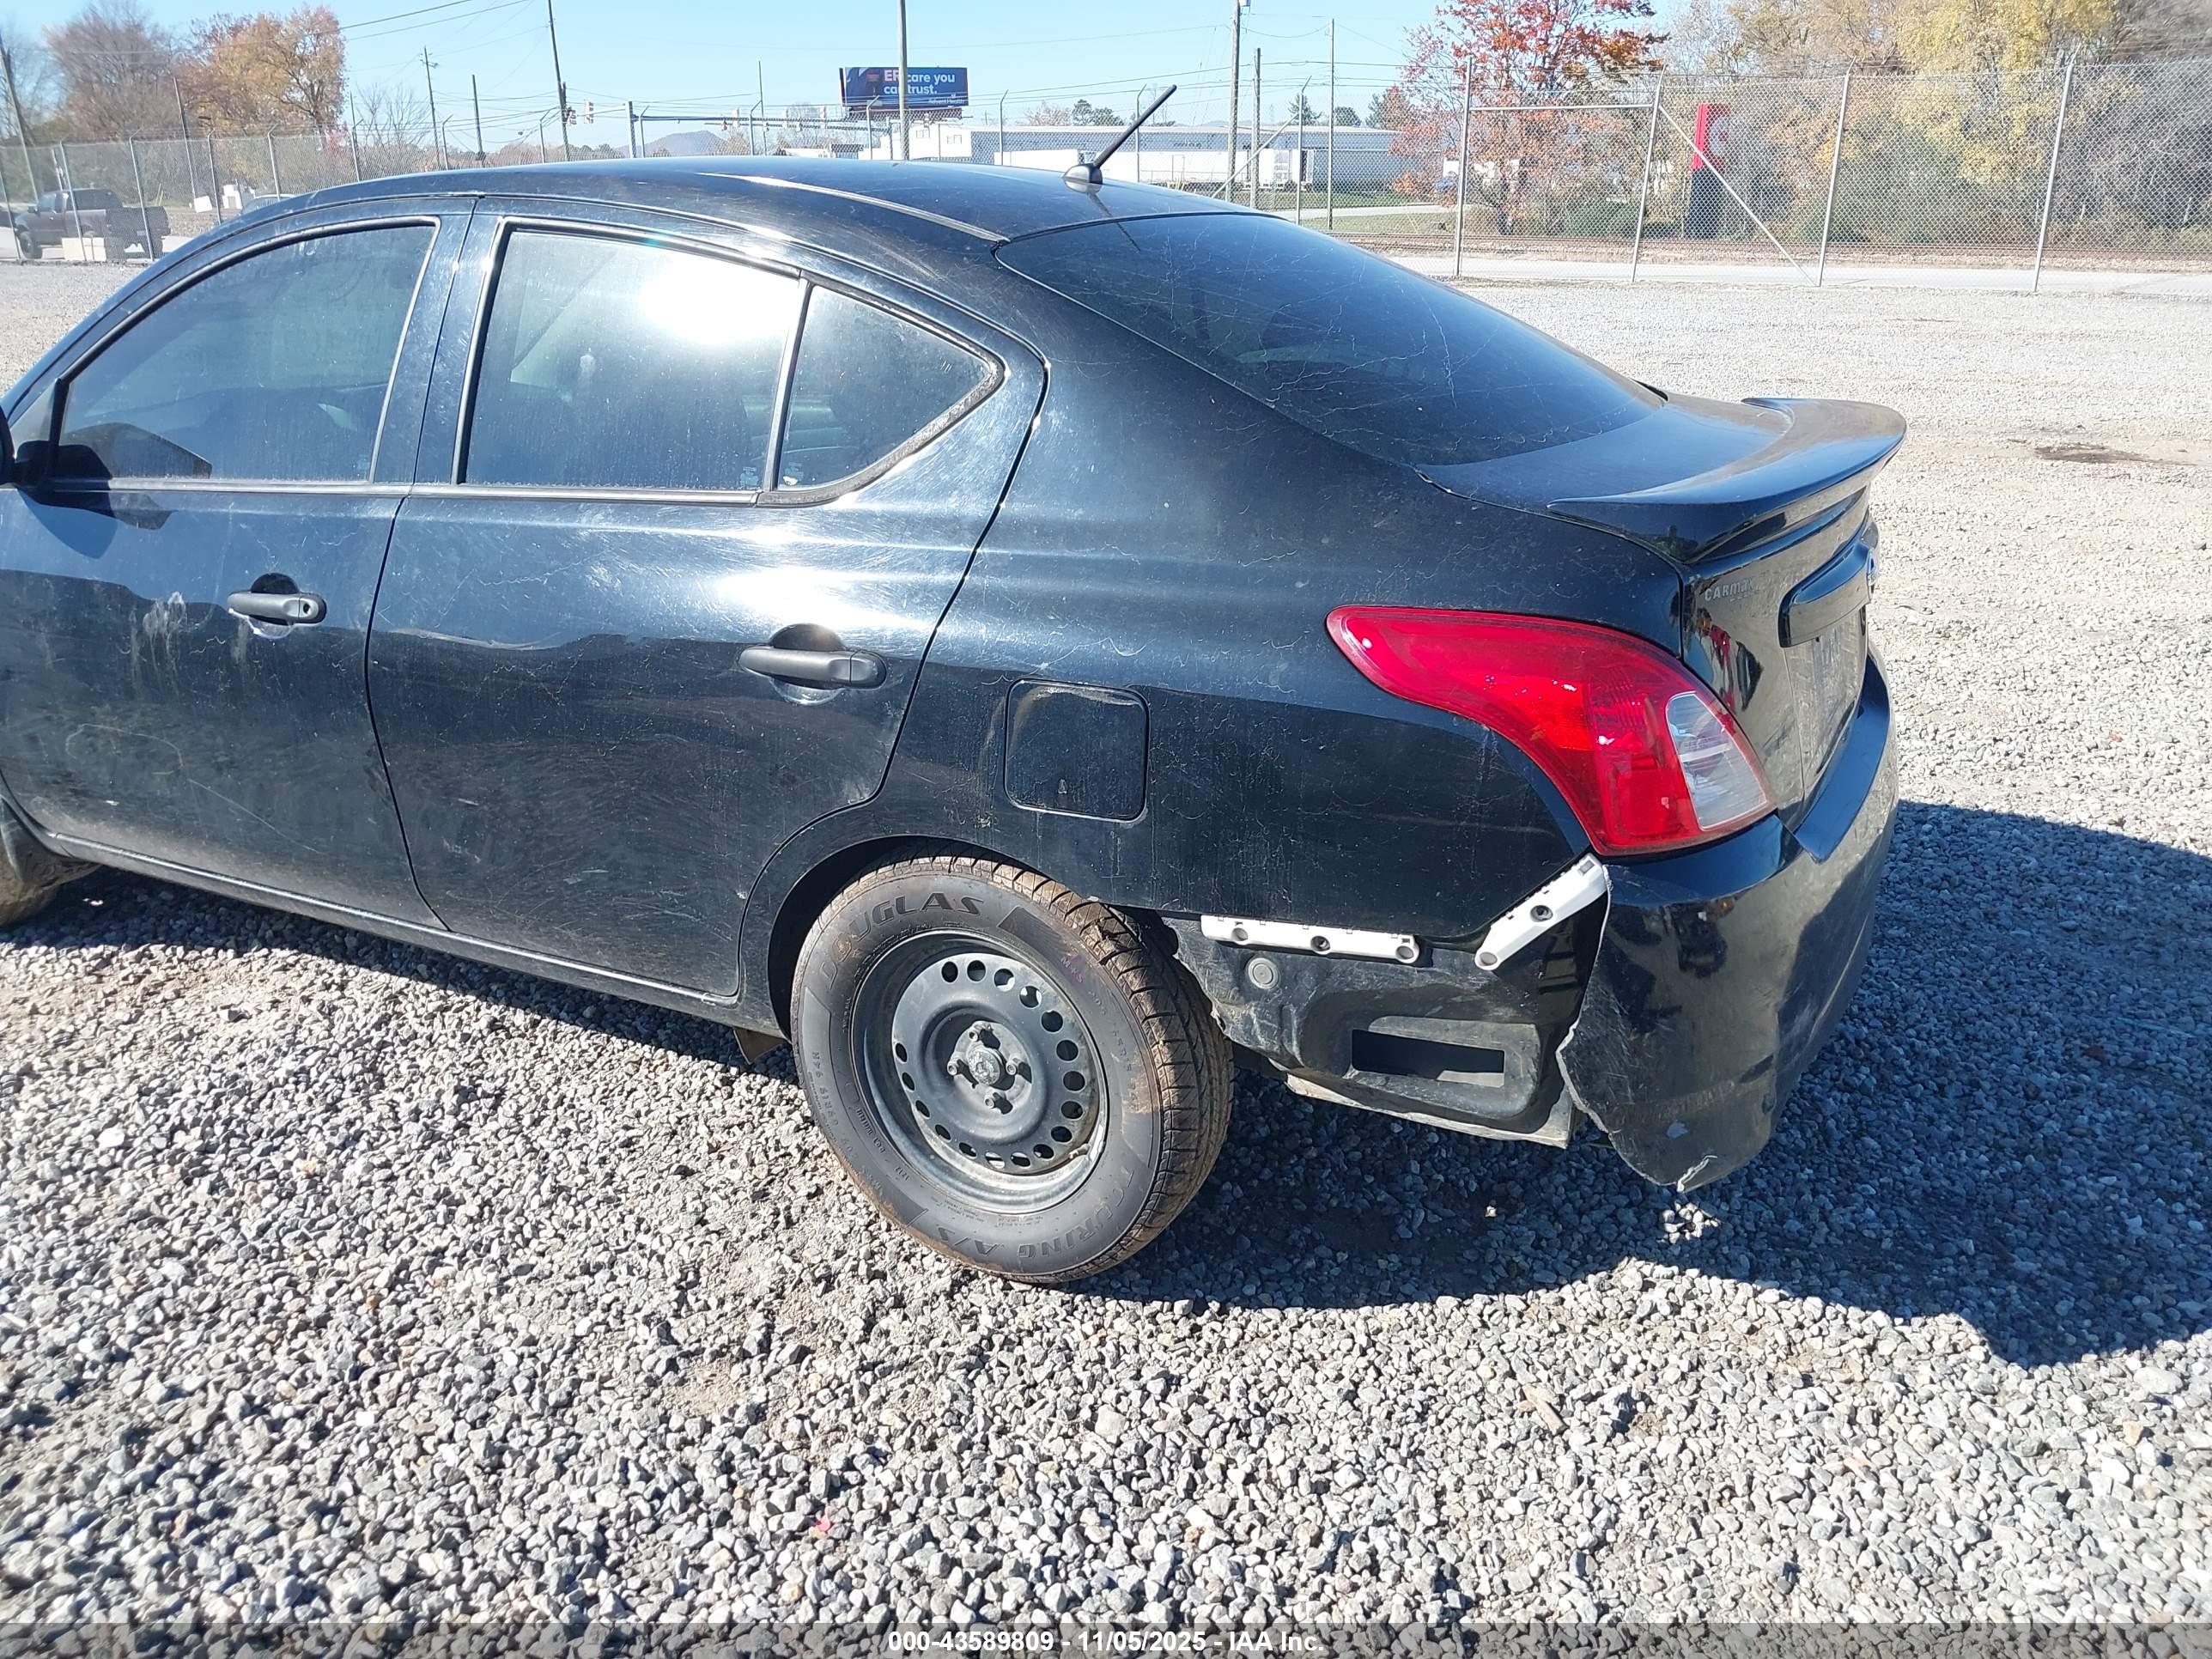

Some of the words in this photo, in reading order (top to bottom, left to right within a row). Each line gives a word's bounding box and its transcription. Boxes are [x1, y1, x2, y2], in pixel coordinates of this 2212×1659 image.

[907, 83, 938, 95] trust.
[934, 74, 955, 85] you
[817, 890, 984, 991] DOUGLAS
[1018, 1166, 1137, 1259] TOURING
[935, 1224, 1005, 1257] A/S
